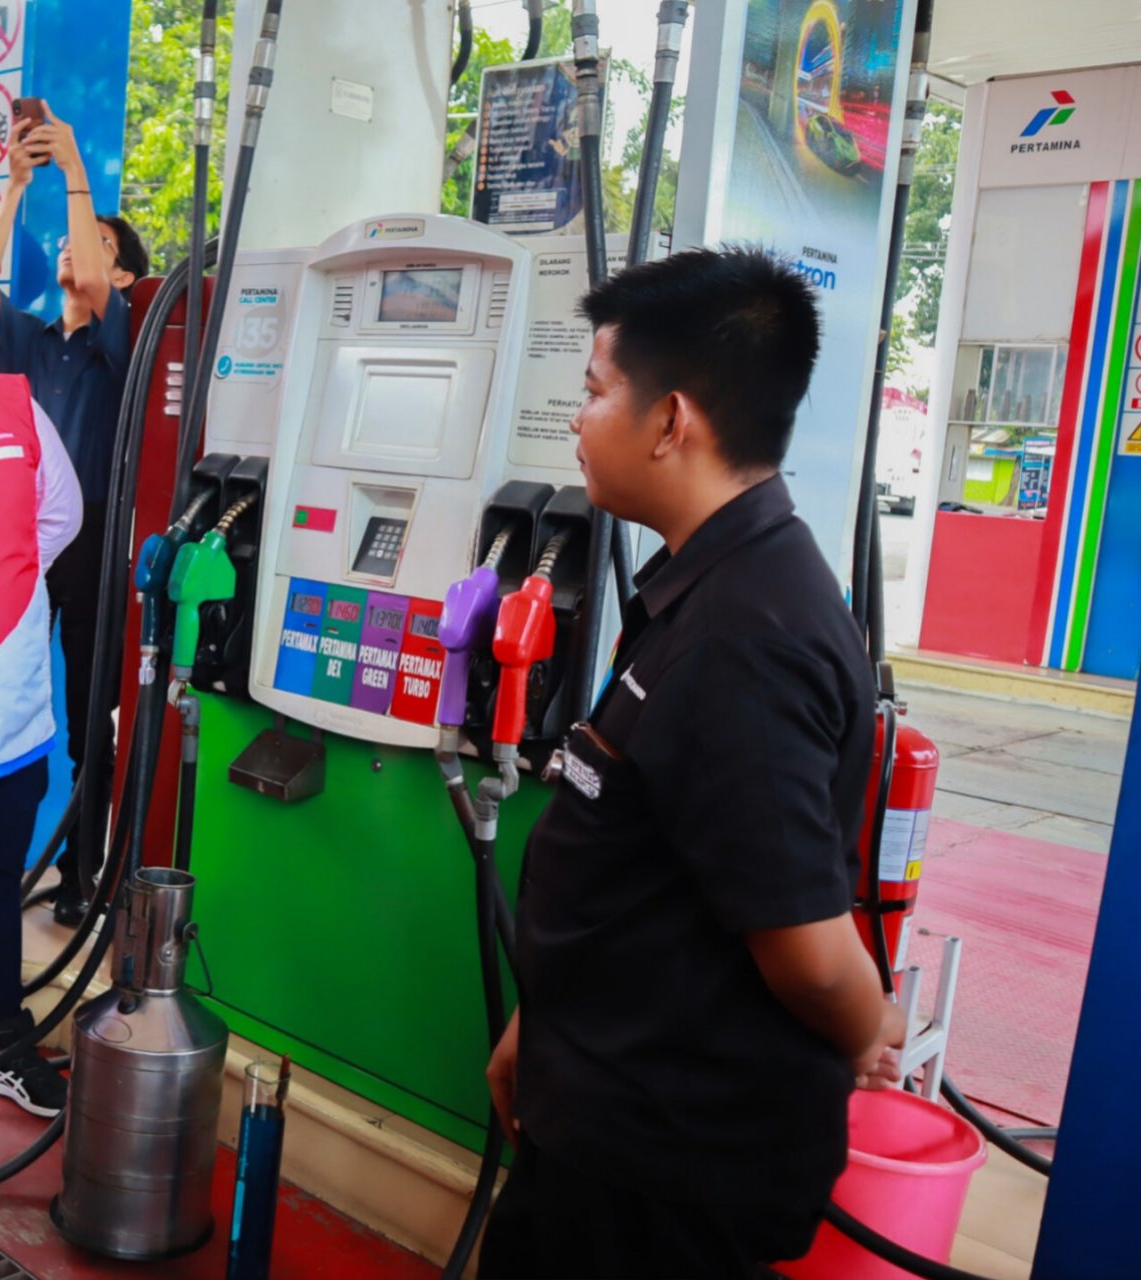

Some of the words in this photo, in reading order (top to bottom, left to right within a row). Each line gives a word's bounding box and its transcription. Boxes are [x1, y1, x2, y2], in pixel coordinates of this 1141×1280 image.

[1010, 140, 1081, 153] PERTAMINA
[540, 258, 572, 266] DILARANG
[802, 246, 838, 264] PERTAMINA
[239, 296, 253, 304] CALL
[255, 296, 277, 304] CENTER
[240, 288, 278, 296] PERTAMINA
[236, 316, 278, 349] 135
[281, 629, 319, 653] PERTAMAX
[319, 636, 358, 661] PERTAMINA
[326, 658, 343, 678] DEX
[358, 645, 399, 670] PERTAMAX
[398, 653, 443, 680] PERTAMAX
[362, 667, 389, 690] GREEN
[403, 676, 431, 699] TURBO
